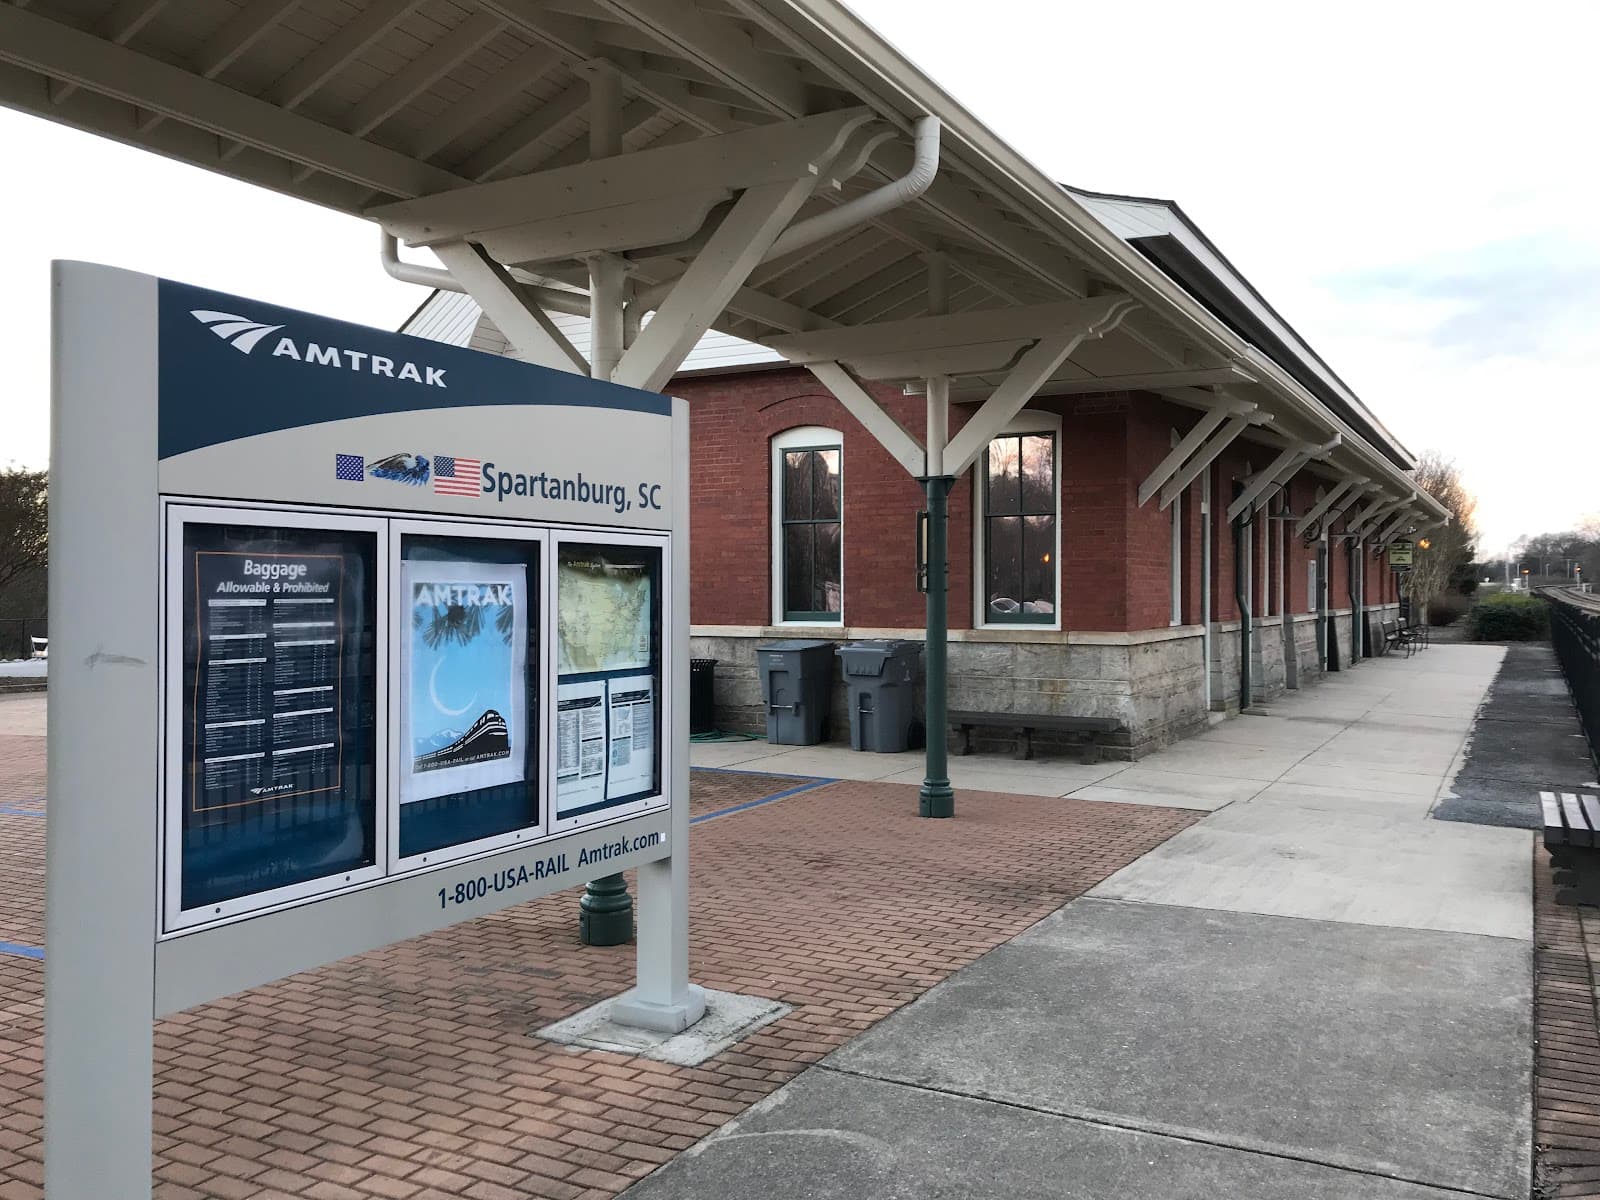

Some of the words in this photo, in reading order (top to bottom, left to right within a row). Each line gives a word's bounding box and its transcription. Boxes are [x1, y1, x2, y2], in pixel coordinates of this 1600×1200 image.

[272, 337, 448, 388] AMTRAK
[482, 462, 632, 514] Spartanburg,
[638, 482, 662, 511] SC
[243, 559, 308, 580] Baggage
[216, 581, 271, 593] Allowable
[272, 582, 281, 593] &
[282, 582, 330, 593] Prohibited
[415, 583, 513, 607] AMTRAK
[262, 783, 295, 793] AMTRAK
[437, 853, 570, 909] 1-800-USA-RAIL
[578, 831, 660, 868] Amtrak.com
